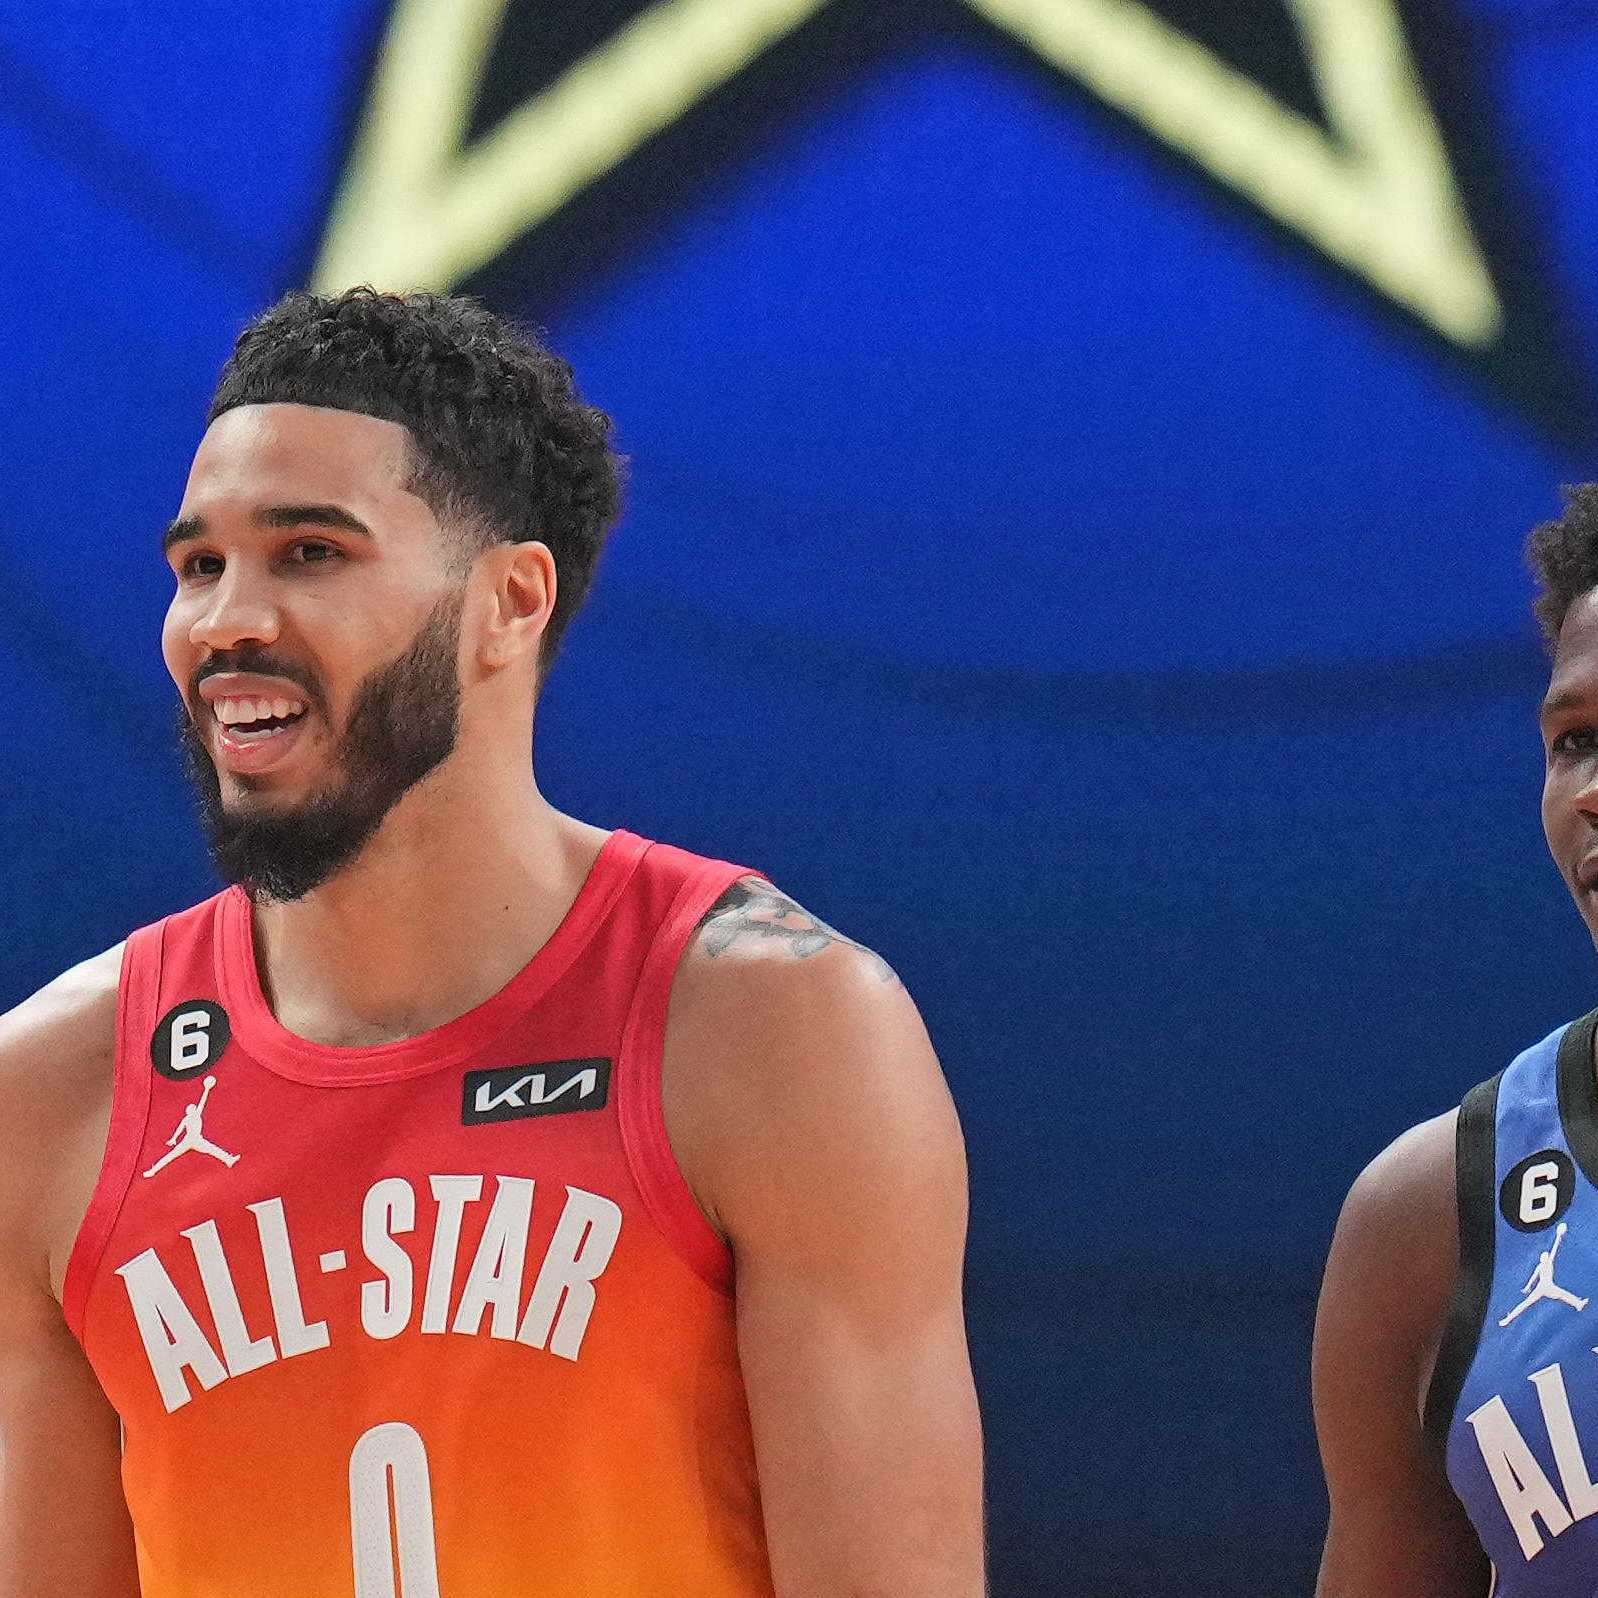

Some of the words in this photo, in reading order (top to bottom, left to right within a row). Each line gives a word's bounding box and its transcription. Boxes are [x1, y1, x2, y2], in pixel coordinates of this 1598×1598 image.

[170, 1010, 211, 1071] 6
[473, 1067, 598, 1114] KIA
[1519, 1161, 1559, 1224] 6
[114, 1174, 623, 1415] ALL-STAR
